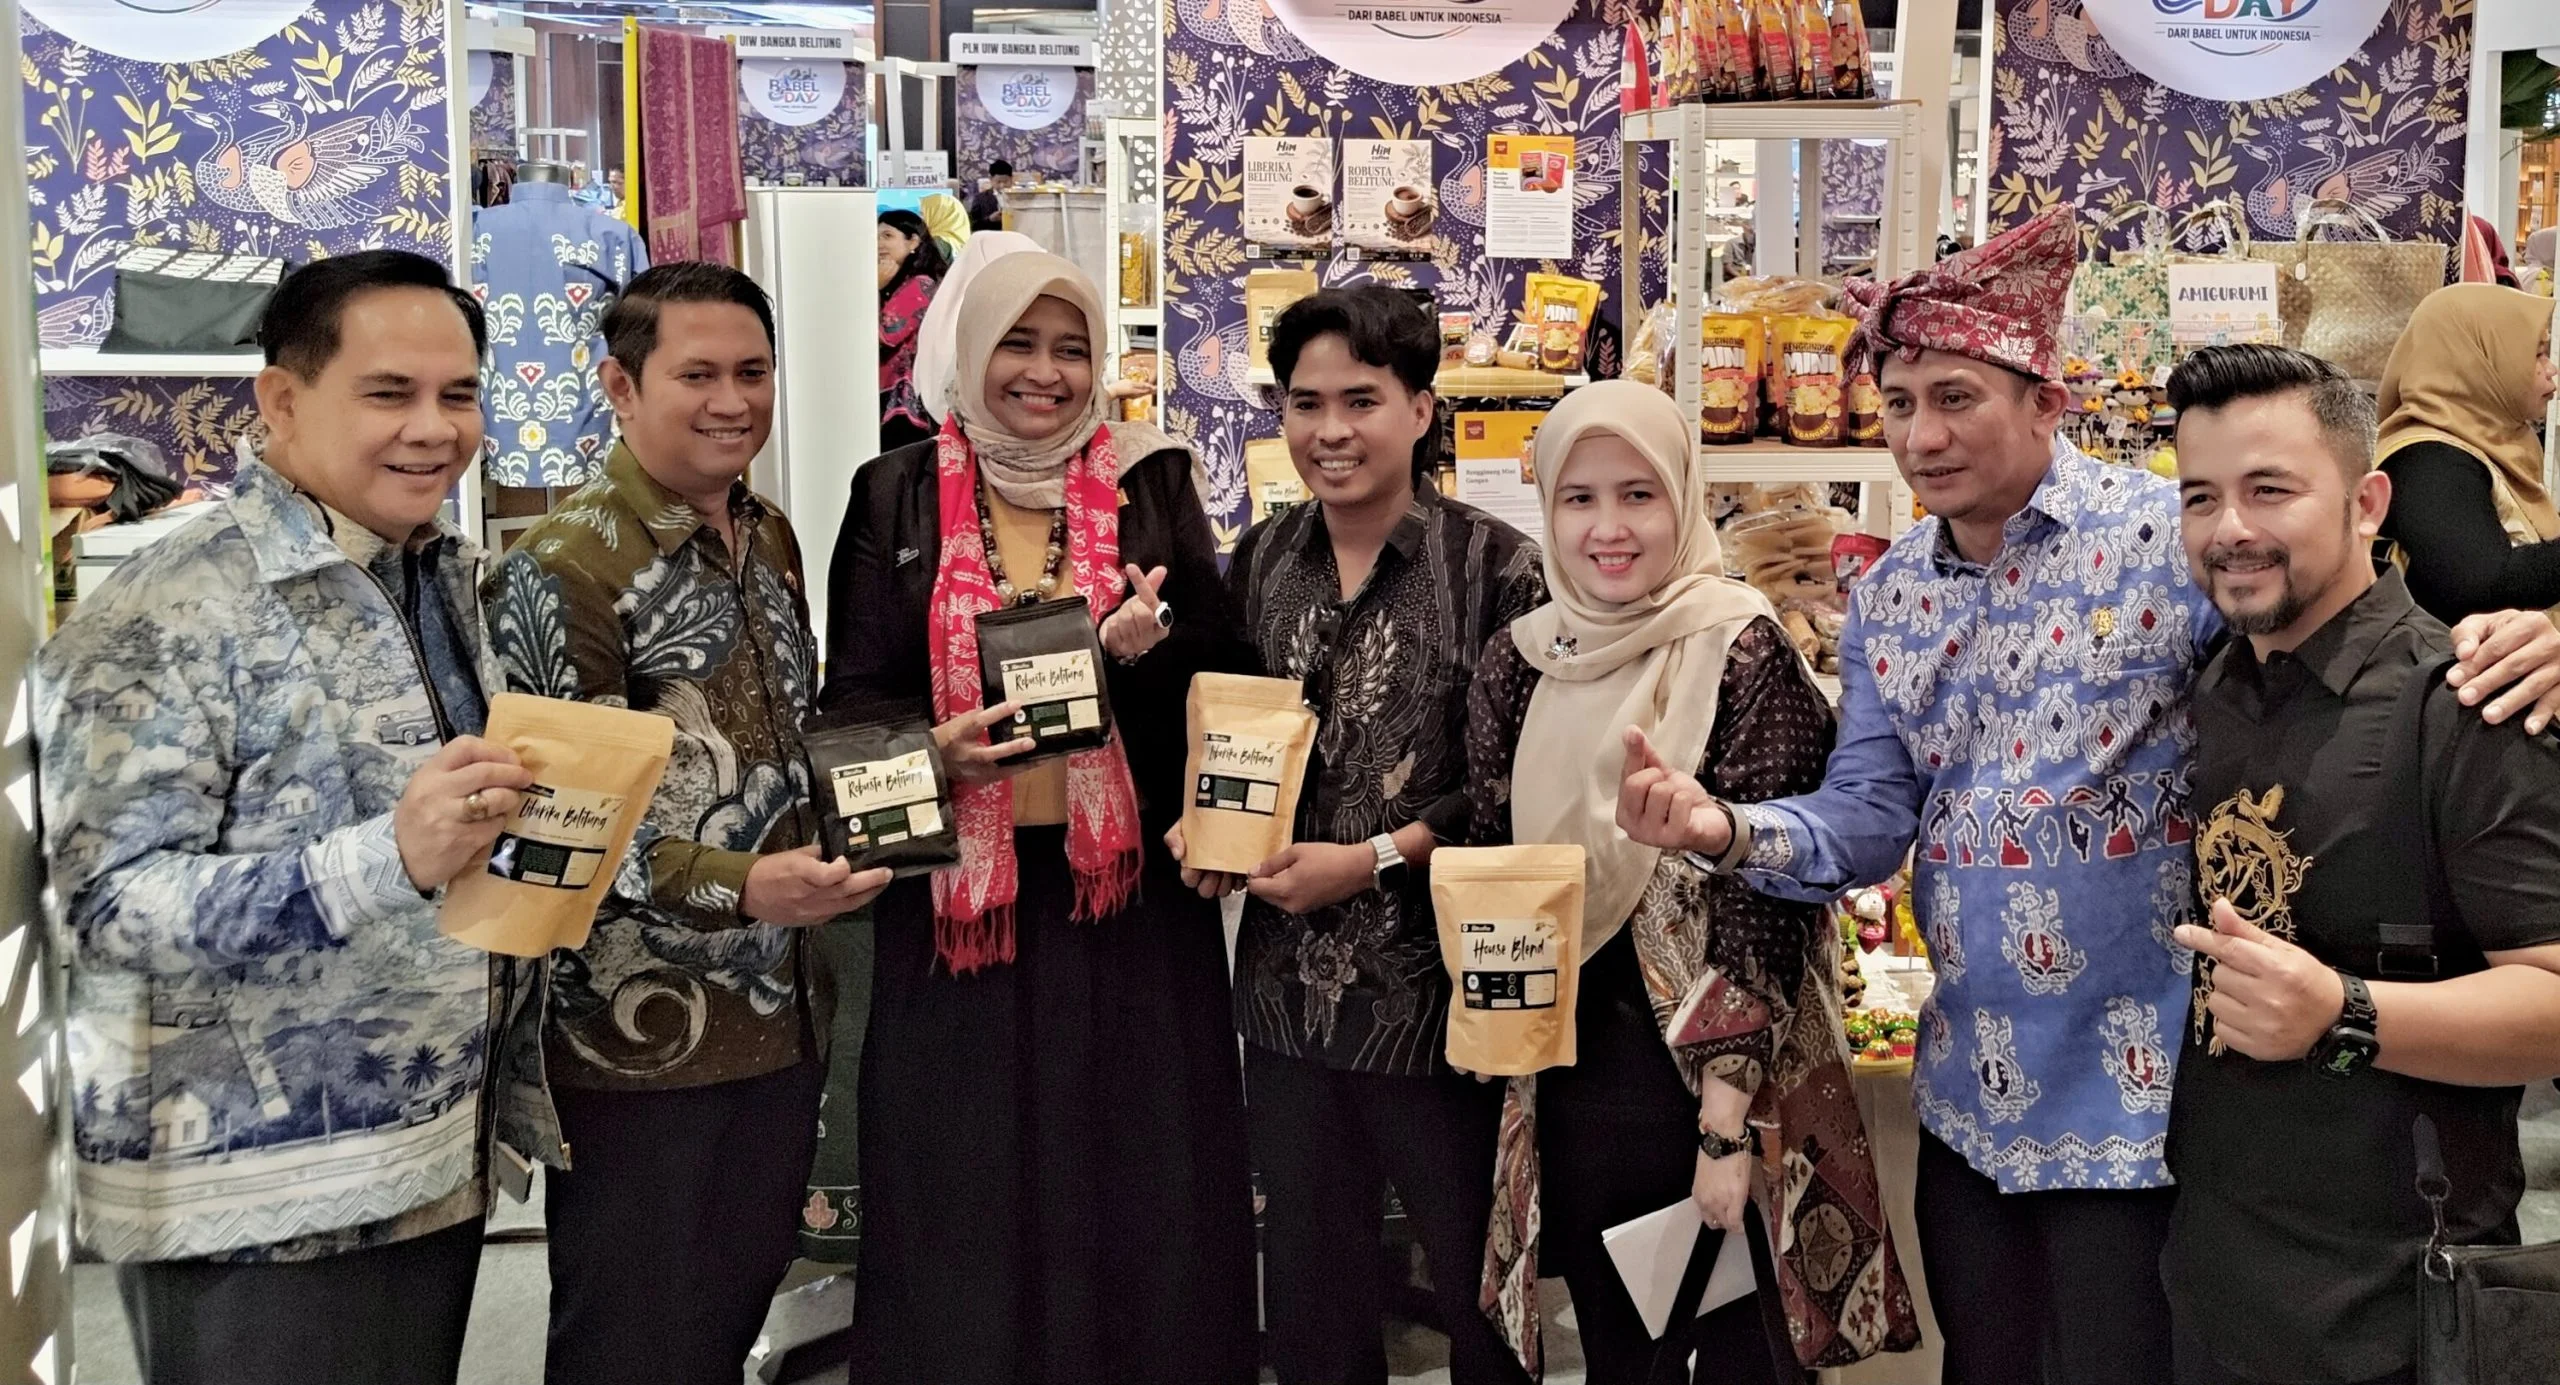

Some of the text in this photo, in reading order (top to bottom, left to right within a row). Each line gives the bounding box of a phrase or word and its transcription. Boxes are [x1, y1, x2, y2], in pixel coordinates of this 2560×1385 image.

[1348, 10, 1502, 23] DARI BABEL UNTUK INDONESIA
[2167, 28, 2311, 41] DARI BABEL UNTUK INDONESIA
[740, 35, 757, 47] UIW
[760, 36, 797, 48] BANGKA
[799, 37, 842, 49] BELITUNG
[962, 42, 1080, 56] PLN UIW BANGKA BELITUNG
[1872, 61, 1893, 71] NGKA
[769, 77, 820, 92] BABEL
[1003, 82, 1051, 97] BABEL
[784, 91, 814, 103] DAY
[1017, 96, 1047, 108] DAY
[1247, 161, 1292, 172] LIBERIKA
[1347, 165, 1392, 177] ROBUSTA
[1247, 172, 1293, 183] BELITUNG
[1347, 176, 1396, 187] BELITUNG
[2178, 286, 2268, 302] AMIGURUMI
[1784, 352, 1837, 378] MINI
[1015, 666, 1084, 692] Robusta Belitung
[1239, 747, 1274, 768] Belitung
[847, 776, 881, 799] Robusta
[518, 796, 608, 833] Liberika Belitung
[1473, 934, 1545, 965] House Blend
